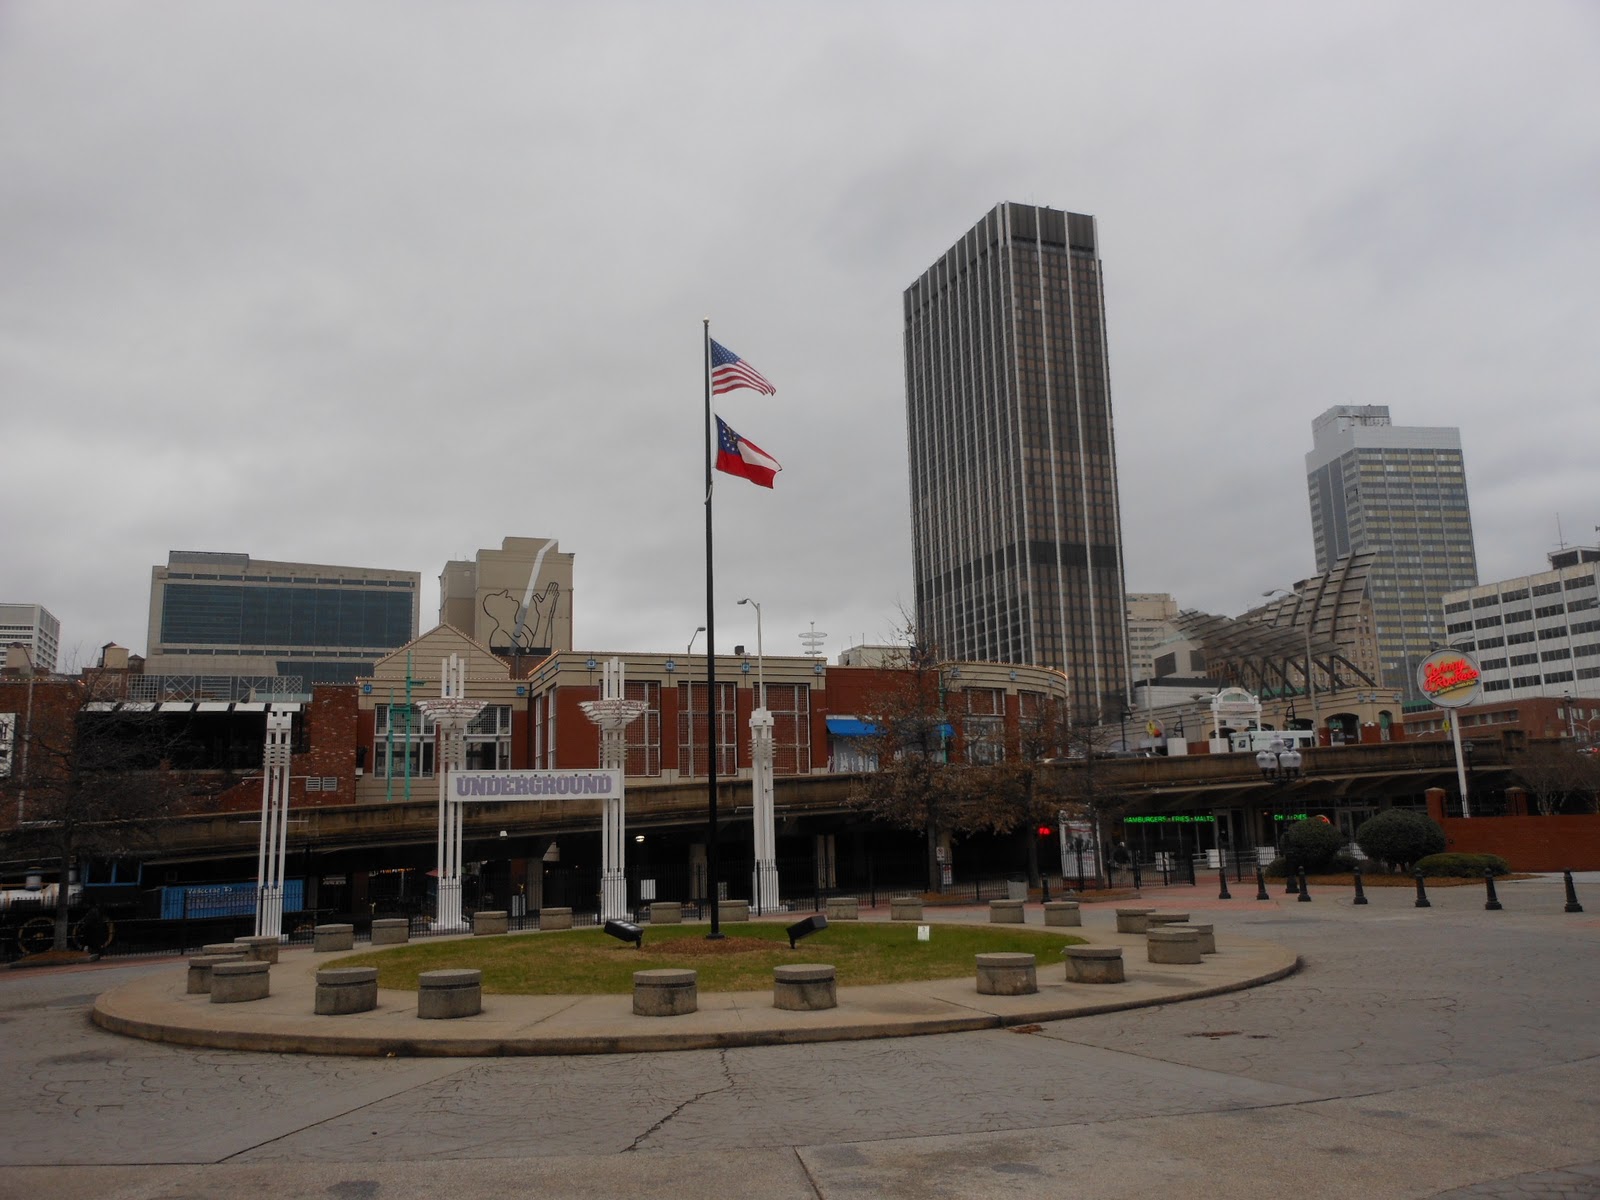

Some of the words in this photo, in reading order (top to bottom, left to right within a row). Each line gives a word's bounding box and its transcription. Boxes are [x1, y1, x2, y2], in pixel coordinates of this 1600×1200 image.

[456, 774, 611, 796] UNDERGROUND
[1123, 815, 1166, 823] HAMBURGERS
[1171, 815, 1190, 823] FRIES
[1193, 815, 1214, 823] MALTS
